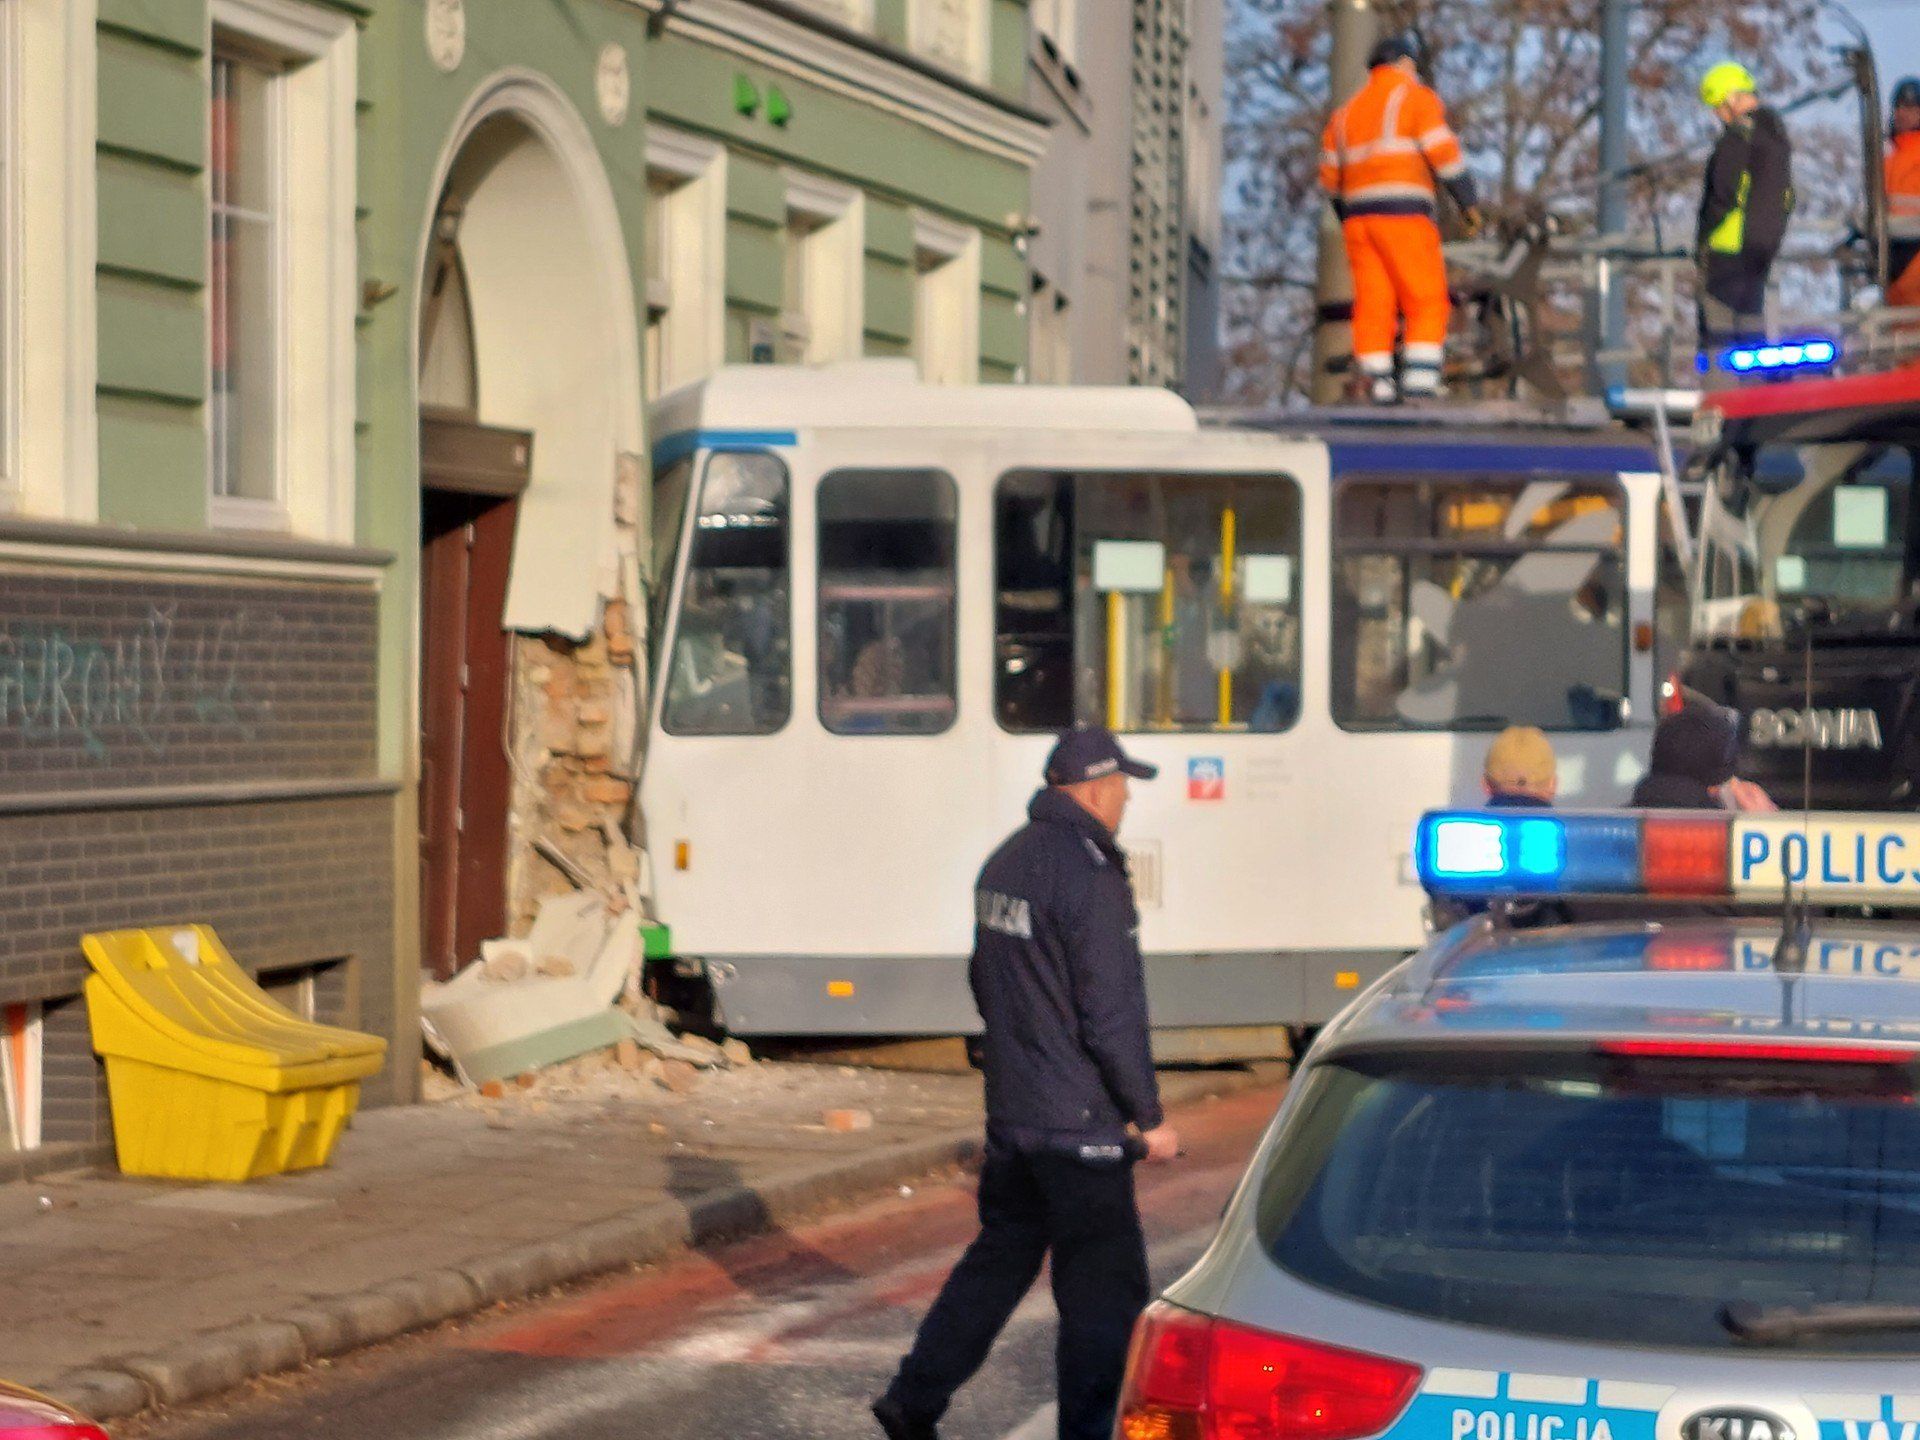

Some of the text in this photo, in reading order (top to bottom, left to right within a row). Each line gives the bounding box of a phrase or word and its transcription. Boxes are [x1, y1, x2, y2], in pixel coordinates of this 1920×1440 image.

[1750, 707, 1883, 751] SCANIA
[1452, 1408, 1614, 1440] POLICJA
[1697, 1416, 1775, 1440] KIA
